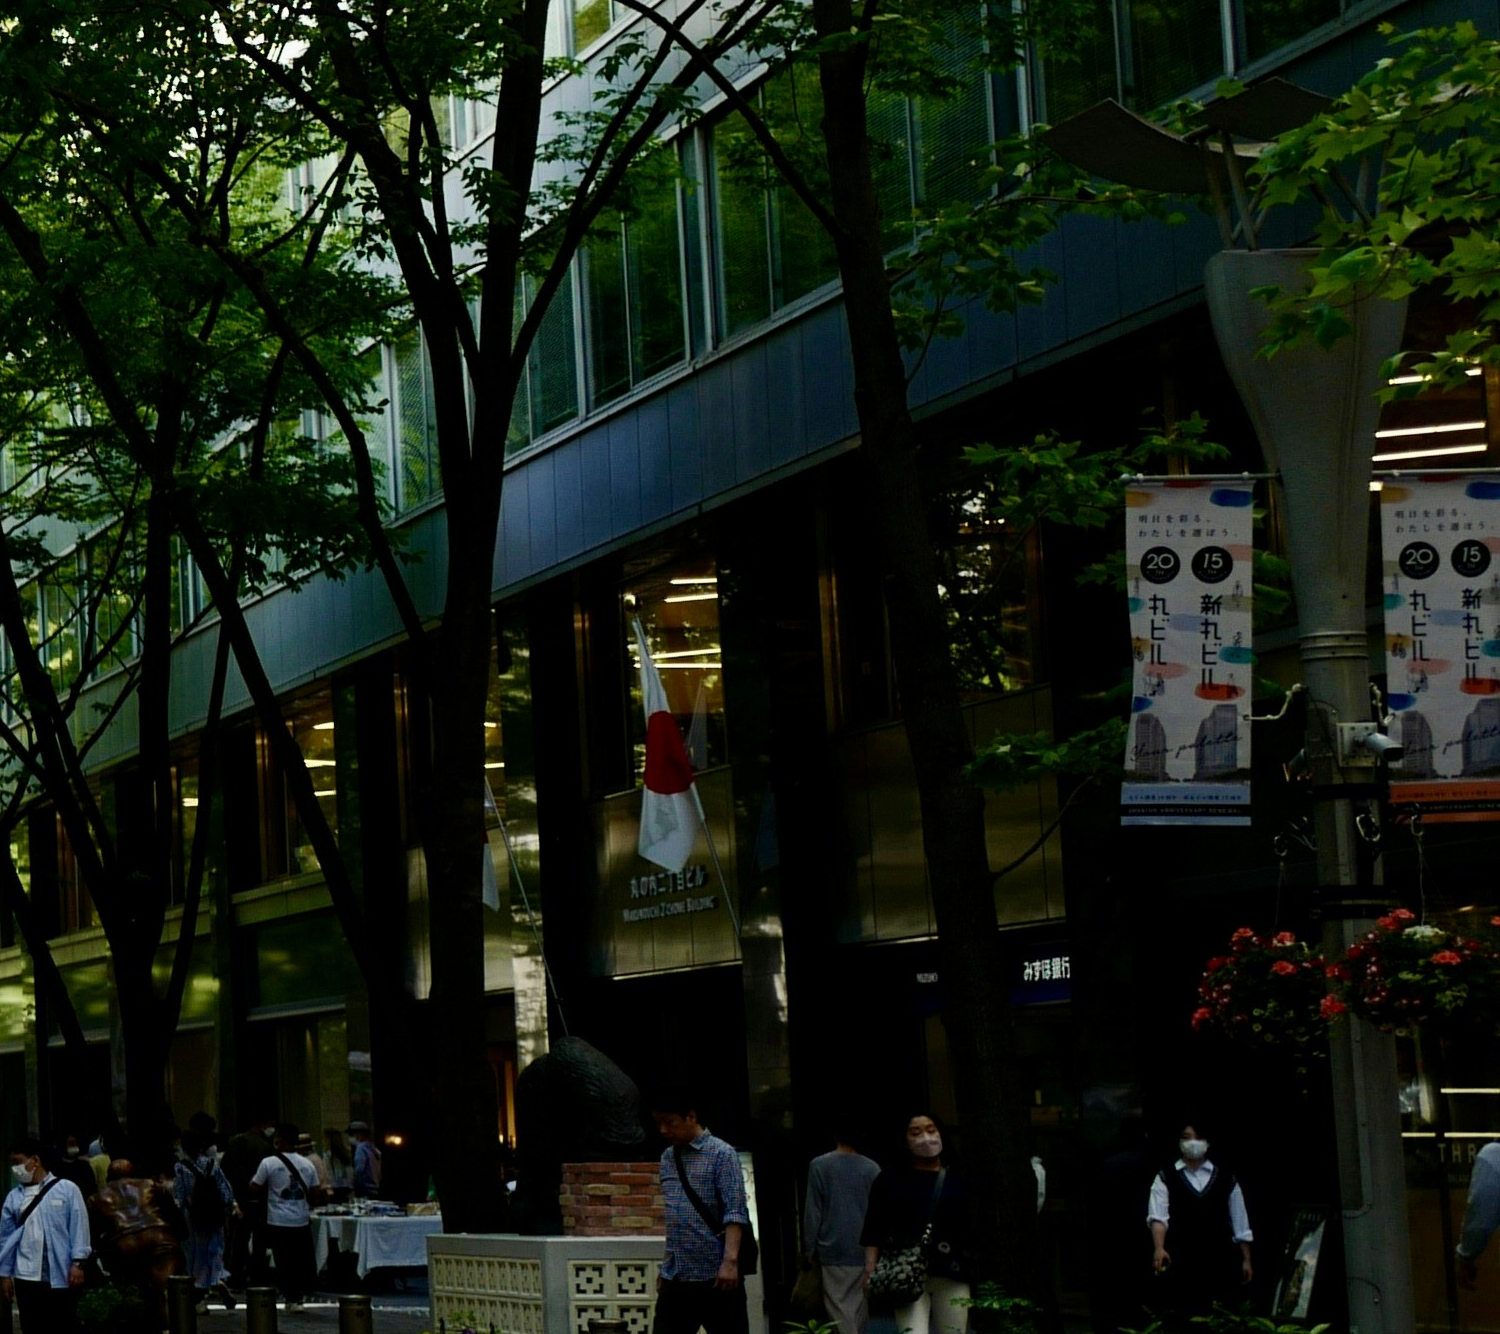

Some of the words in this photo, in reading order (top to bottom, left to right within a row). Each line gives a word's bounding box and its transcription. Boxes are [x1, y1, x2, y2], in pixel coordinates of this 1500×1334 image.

[1146, 553, 1175, 570] 20
[1204, 553, 1224, 569] 15
[1405, 549, 1434, 565] 20
[1462, 546, 1482, 563] 15
[1149, 594, 1170, 665] 丸ビル
[1409, 589, 1431, 662] 丸ビル
[1461, 588, 1483, 684] 新丸ビル
[1201, 594, 1223, 691] 新丸ビル
[1023, 956, 1071, 982] みずほ銀行
[1436, 1142, 1479, 1164] THR
